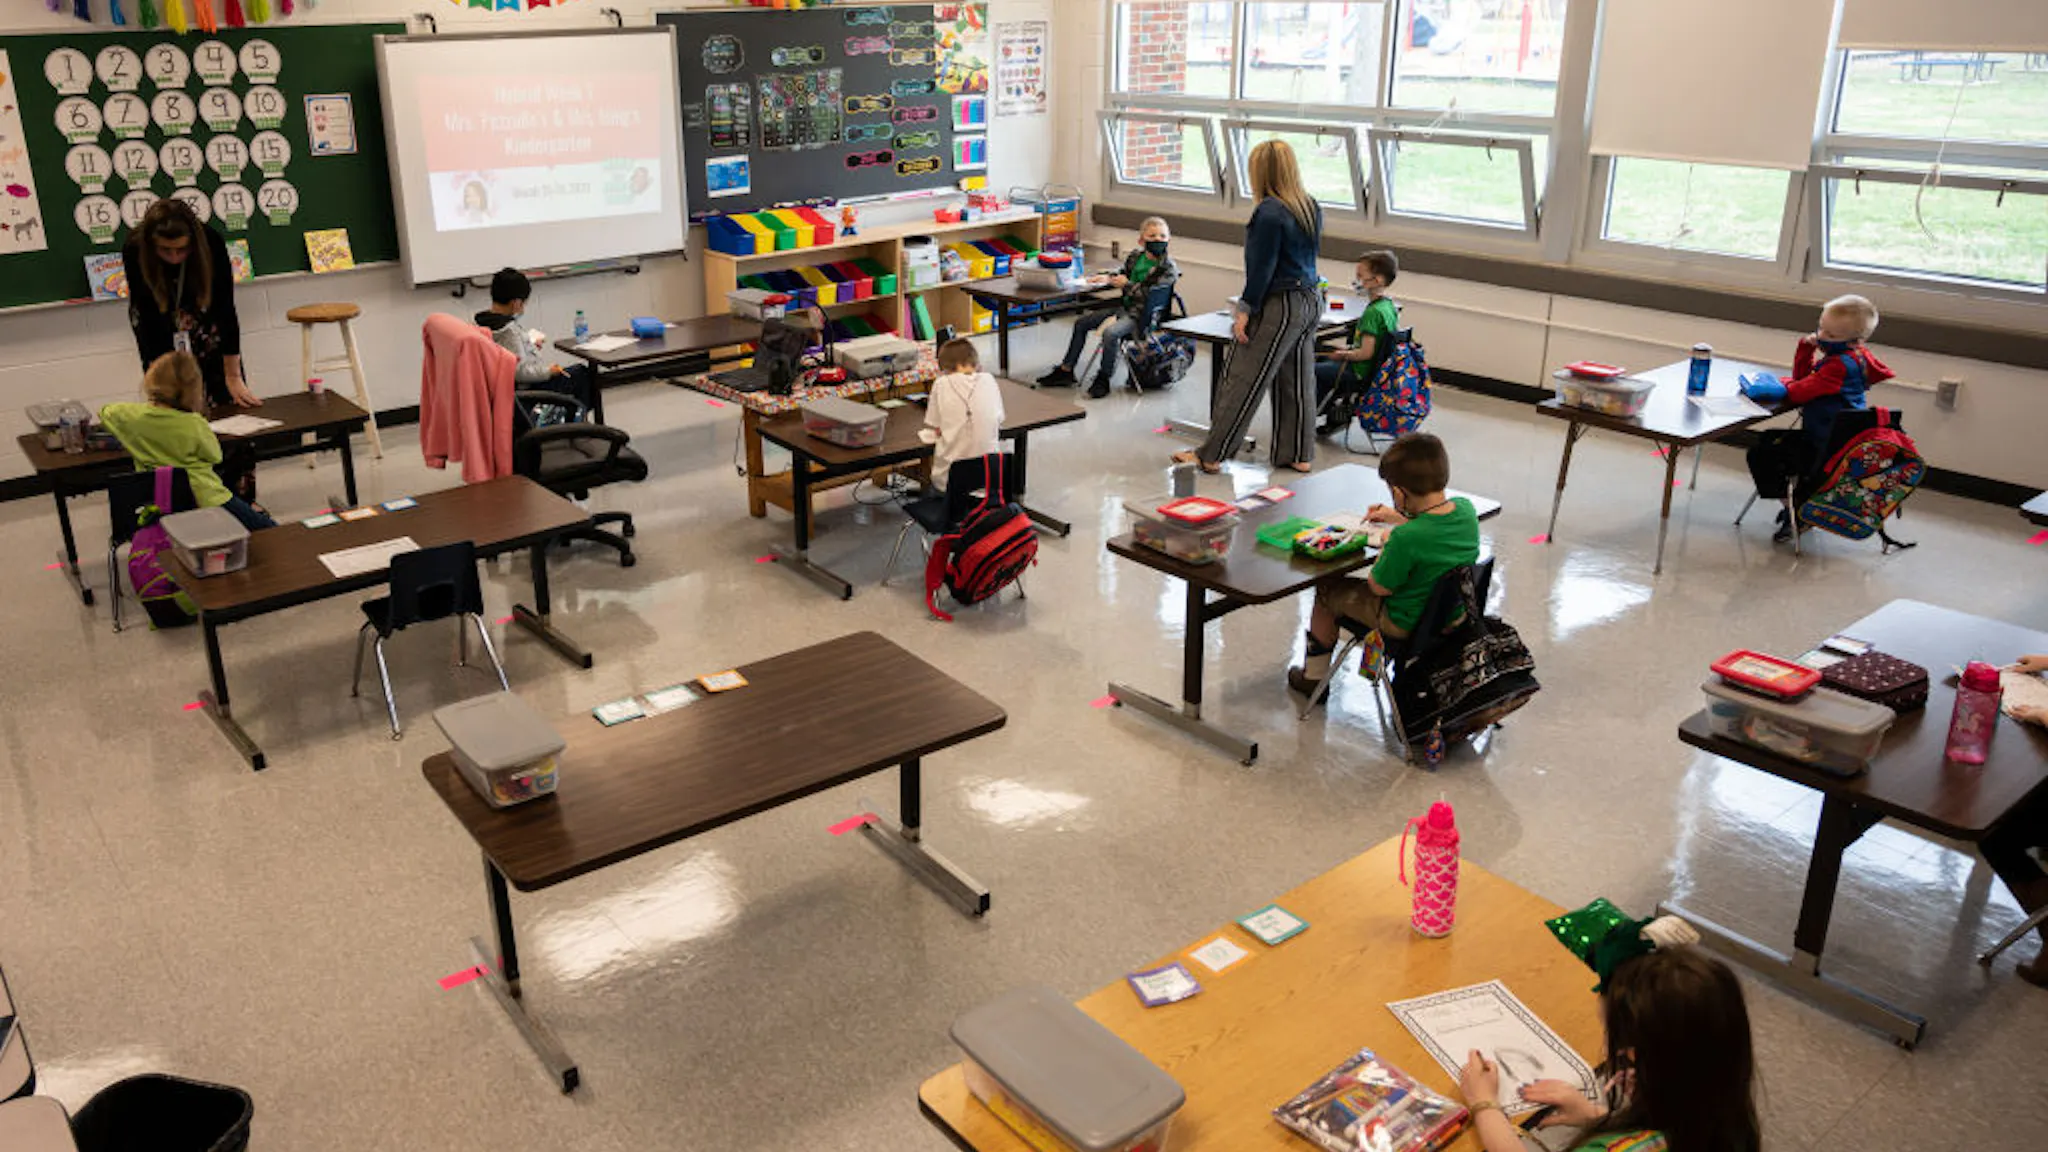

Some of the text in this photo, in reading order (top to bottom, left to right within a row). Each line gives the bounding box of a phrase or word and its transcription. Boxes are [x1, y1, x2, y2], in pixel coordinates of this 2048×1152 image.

[62, 54, 75, 81] 1
[109, 50, 128, 77] 2
[159, 48, 175, 74] 3
[207, 46, 224, 71] 4
[253, 45, 269, 70] 5
[114, 98, 132, 123] 7
[166, 96, 181, 120] 8
[211, 93, 230, 117] 9
[253, 92, 277, 113] 10
[72, 102, 89, 128] 6
[170, 145, 193, 168] 13
[214, 142, 239, 163] 14
[260, 138, 281, 160] 15
[505, 135, 592, 156] Kindergarten
[78, 151, 95, 173] 11
[124, 147, 147, 170] 12
[220, 190, 246, 212] 19
[263, 187, 293, 208] 20
[84, 202, 111, 224] 16
